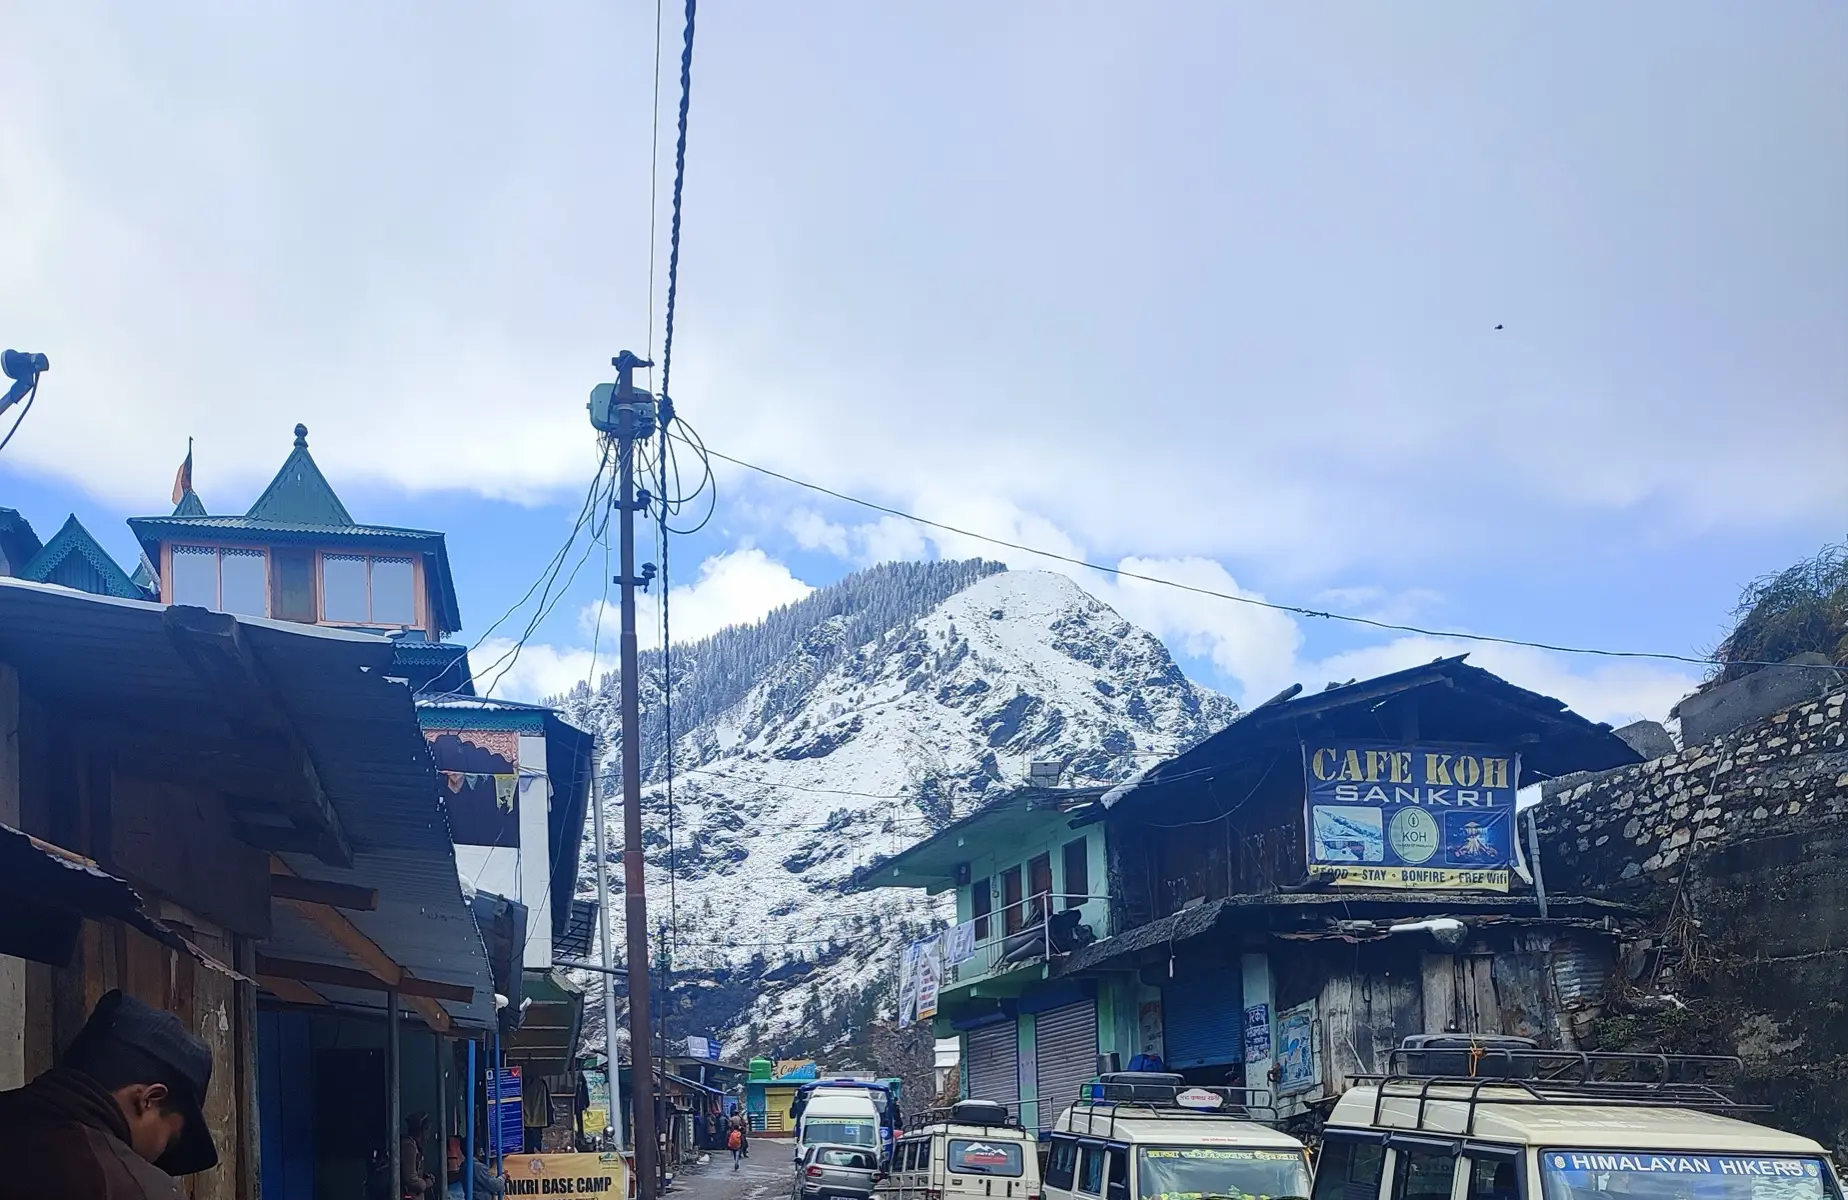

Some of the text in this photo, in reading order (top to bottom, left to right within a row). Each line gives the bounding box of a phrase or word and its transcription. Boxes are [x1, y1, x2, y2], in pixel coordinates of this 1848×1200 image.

[1312, 748, 1509, 789] CAFE KOH
[1335, 785, 1493, 807] SANKRI
[1402, 831, 1427, 843] KOH
[1361, 869, 1387, 881] STAY
[1401, 870, 1446, 883] BONFIRE
[1458, 872, 1483, 884] FREE
[1486, 870, 1508, 885] Wifi
[1572, 1154, 1803, 1177] HIMALAYAN HIKERS
[542, 1177, 574, 1194] BASE
[576, 1176, 612, 1193] CAMP
